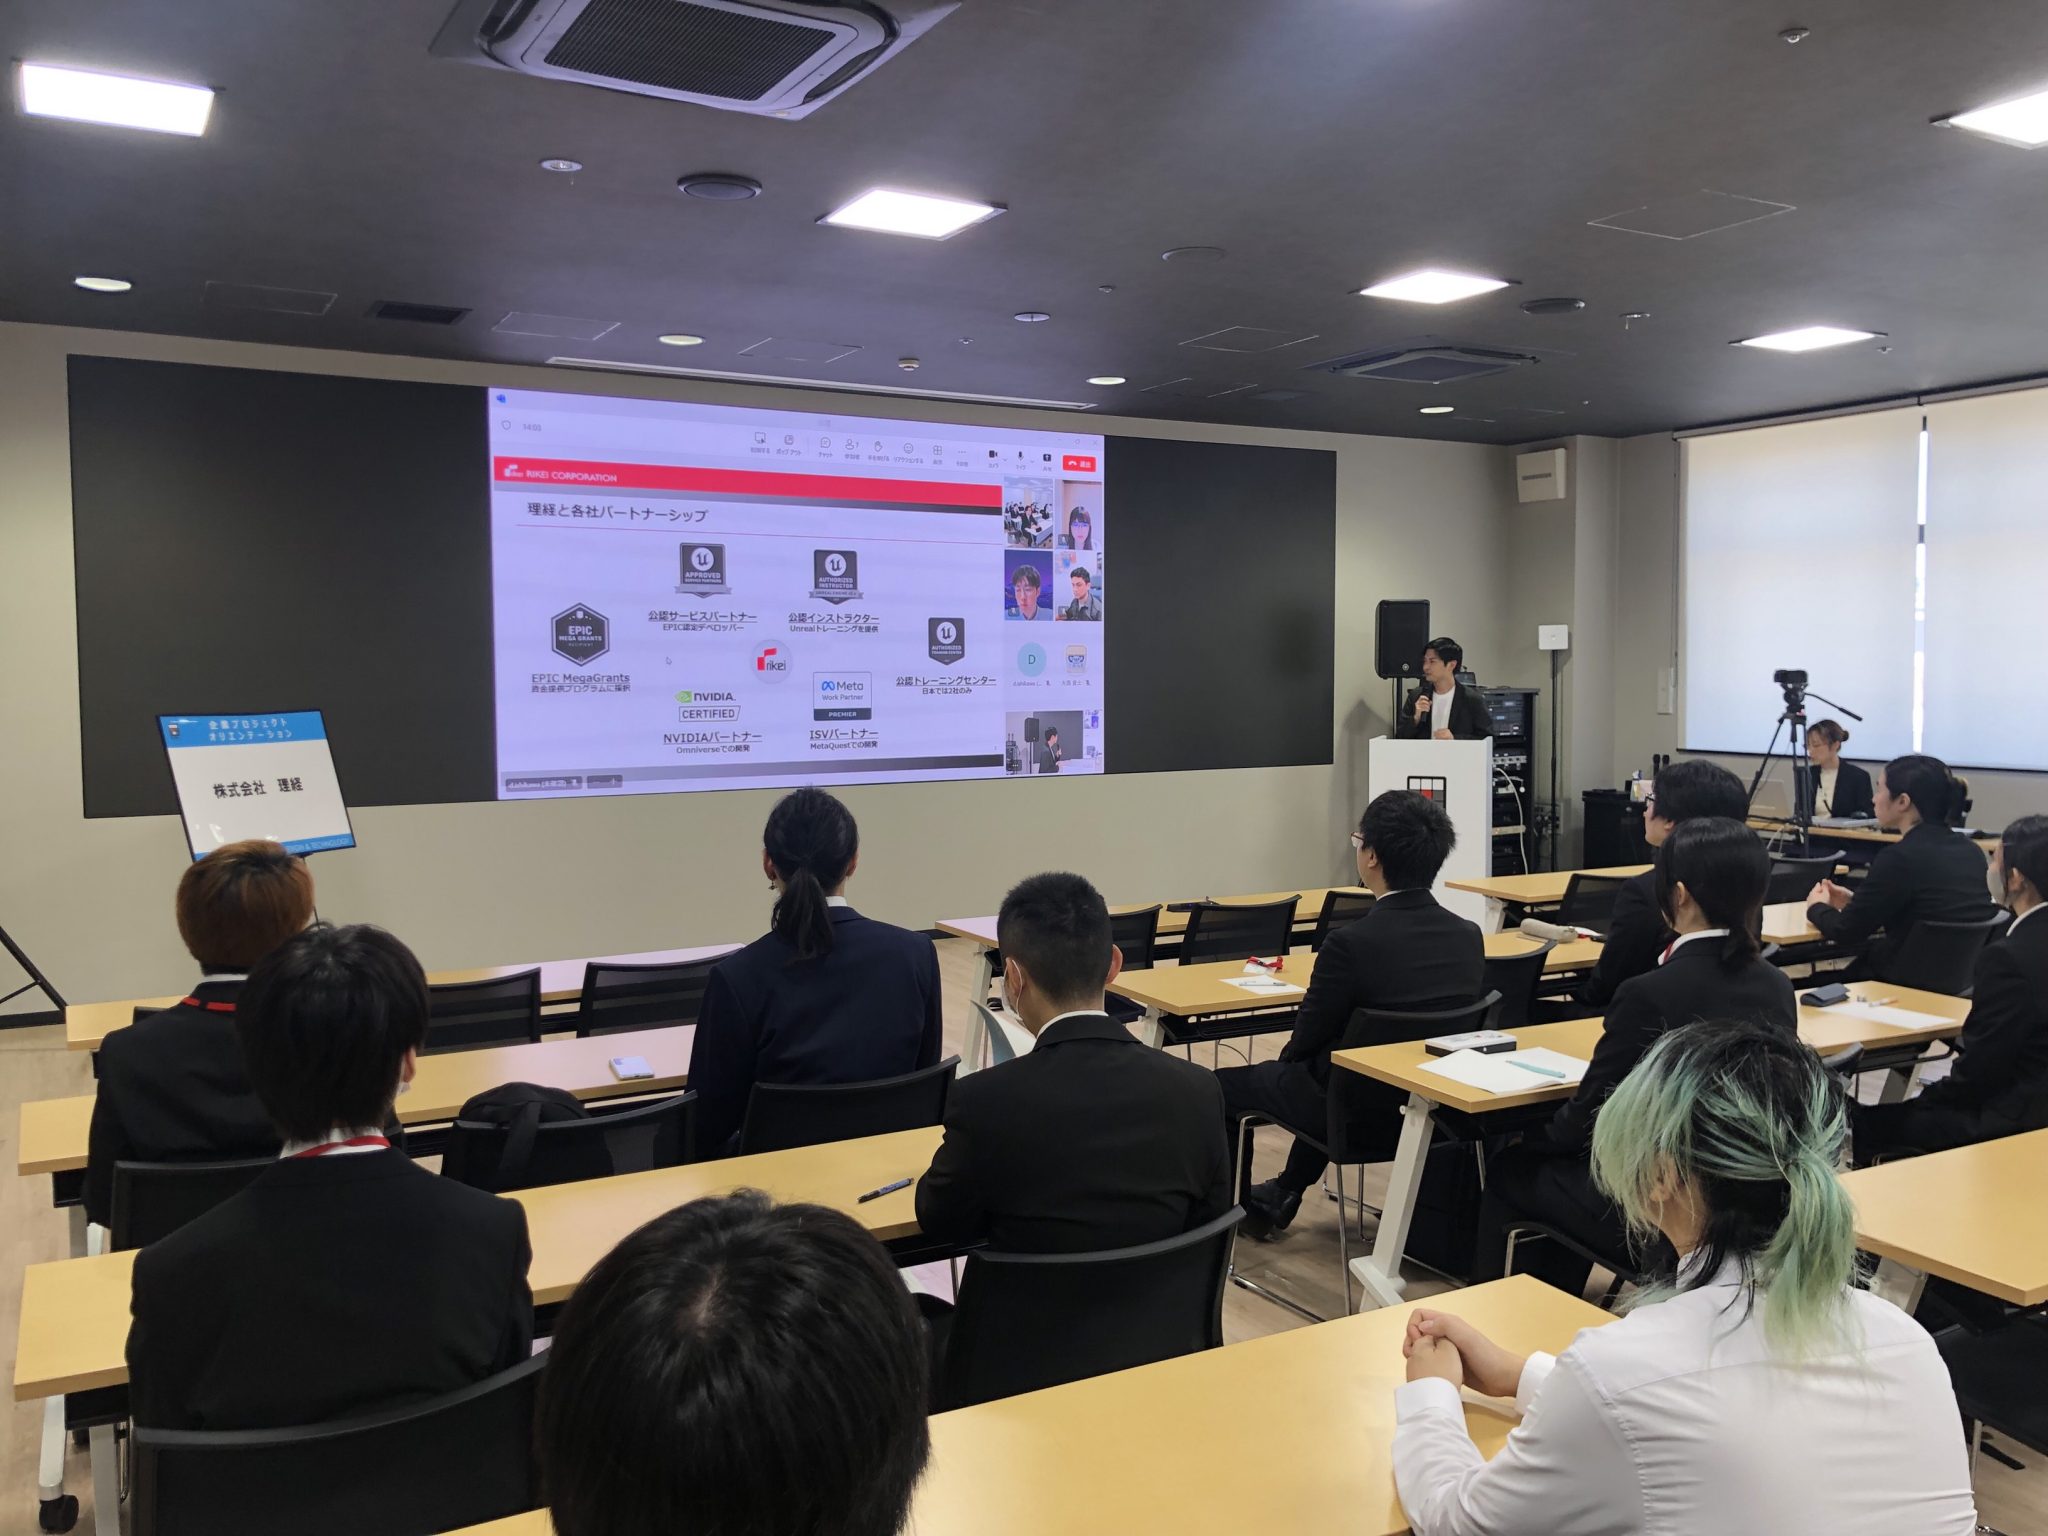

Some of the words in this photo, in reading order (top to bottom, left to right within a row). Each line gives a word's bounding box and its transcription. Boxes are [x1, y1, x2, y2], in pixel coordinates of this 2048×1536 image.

[551, 471, 618, 482] CORPORATION
[685, 571, 721, 579] APPROVED
[568, 625, 593, 636] EPIC
[1028, 654, 1036, 665] D
[531, 673, 560, 683] EPIC
[562, 673, 630, 685] MegaGrants
[836, 681, 864, 691] Meta
[922, 687, 973, 695] 日本では2社のみ
[822, 693, 839, 701] Work
[840, 693, 864, 701] Partner
[682, 708, 736, 719] CERTIFIED
[663, 730, 763, 744] NVIDIAパートナー
[809, 728, 879, 740] ISVパートナー
[212, 779, 268, 799] 株式会社
[276, 776, 304, 793] 理経
